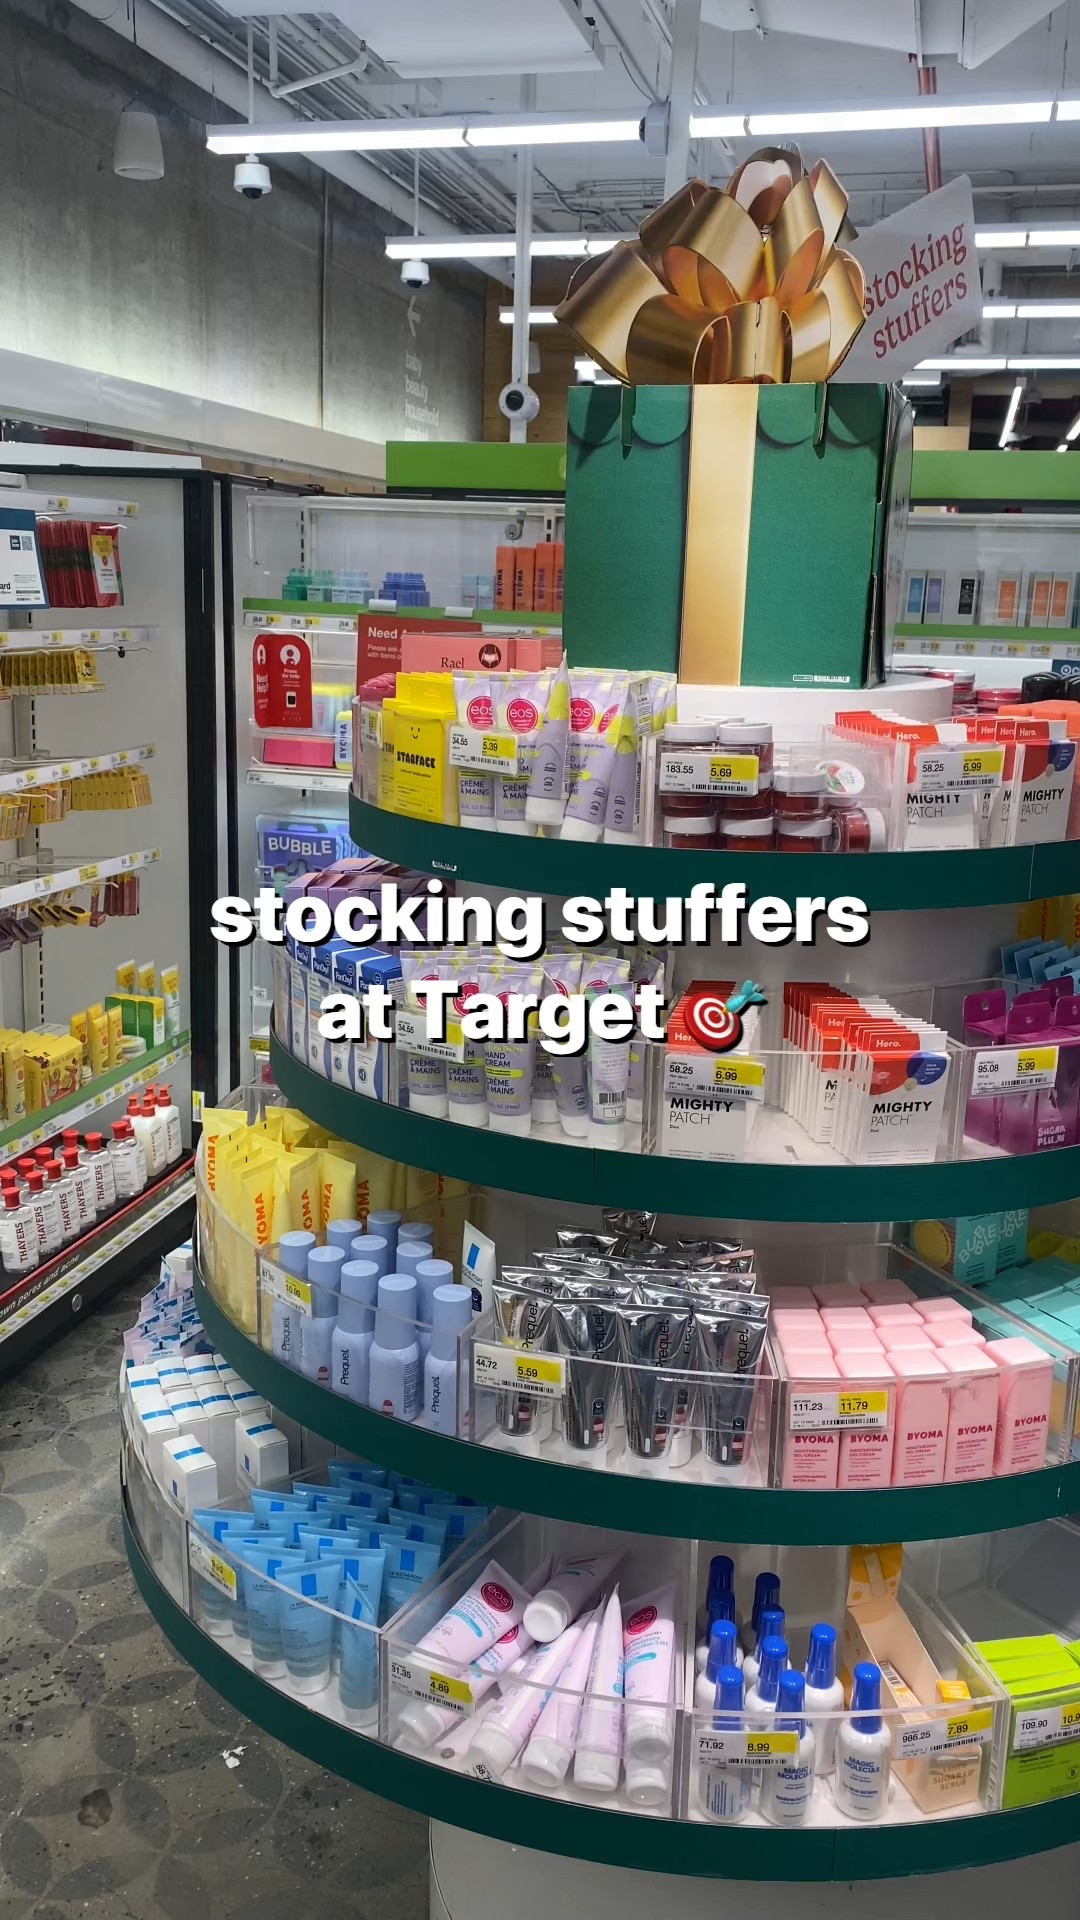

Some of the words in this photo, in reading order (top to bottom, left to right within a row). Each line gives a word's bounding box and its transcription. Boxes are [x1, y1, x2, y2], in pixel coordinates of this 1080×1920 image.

[866, 222, 967, 317] stocking
[873, 271, 967, 359] stuffers
[368, 627, 398, 639] Need
[441, 657, 465, 669] Rael
[509, 708, 534, 718] eos
[896, 731, 921, 741] Hero.
[981, 726, 996, 735] Her
[1019, 728, 1037, 737] Hero.
[452, 736, 469, 747] 34.55
[482, 741, 499, 752] 5.39
[397, 751, 436, 769] STARFACE
[666, 764, 694, 774] 183.55
[710, 767, 732, 778] 5.69
[922, 763, 945, 773] 58.25
[963, 762, 982, 772] 6.99
[465, 787, 490, 796] MAINS
[1023, 788, 1065, 802] MIGHTY
[907, 806, 945, 818] PATCH
[1021, 803, 1050, 816] PATCH
[268, 836, 332, 856] BUBBLE
[313, 958, 330, 976] PanOxyl
[335, 971, 353, 986] PanOxyl
[398, 1023, 415, 1034] 34.55
[828, 1018, 845, 1027] Her
[674, 1032, 696, 1042] Her
[875, 1039, 902, 1048] Hero.
[484, 1052, 506, 1060] HAND
[485, 1058, 511, 1067] CREAM
[416, 1066, 441, 1075] MAINS
[669, 1064, 694, 1075] 58.25
[715, 1070, 738, 1081] 6.99
[977, 1063, 999, 1074] 95.08
[1017, 1062, 1036, 1072] 5.99
[454, 1075, 480, 1083] MAINS
[490, 1086, 515, 1095] MAINS
[669, 1097, 734, 1113] MIGHTY
[872, 1101, 933, 1114] MIGHTY
[669, 1110, 713, 1125] PATCH
[870, 1114, 913, 1127] PATCH
[1038, 1124, 1066, 1137] SUGAR
[95, 1164, 105, 1202] THAYERS
[75, 1180, 88, 1220] THAYERS
[356, 1179, 370, 1221] OMA
[59, 1193, 72, 1232] THAYERS
[301, 1188, 313, 1231] OMA
[254, 1191, 268, 1246] YOMA
[34, 1206, 47, 1246] THAYERS
[15, 1222, 29, 1263] THAYERS
[958, 1225, 997, 1264] BUBBLE
[18, 1282, 43, 1307] pores
[43, 1267, 59, 1287] and
[60, 1254, 80, 1272] acne
[285, 1282, 301, 1299] 10.99
[475, 1359, 498, 1370] 44.72
[517, 1366, 538, 1378] 5.59
[793, 1402, 824, 1412] 111.23
[840, 1401, 869, 1412] 11.79
[1014, 1414, 1048, 1427] BYOMA
[907, 1430, 944, 1441] BYOMA
[957, 1424, 993, 1436] BYOMA
[795, 1434, 835, 1444] BYOMA
[850, 1433, 889, 1443] BYOMA
[487, 1584, 509, 1606] eos
[631, 1610, 653, 1626] eos
[391, 1664, 411, 1679] 31.35
[430, 1680, 450, 1694] 4.89
[1021, 1719, 1048, 1731] 109.90
[1062, 1712, 1080, 1724] 10.9
[902, 1731, 931, 1743] 986.25
[948, 1723, 969, 1736] 7.89
[698, 1740, 724, 1750] 71.92
[747, 1742, 770, 1752] 8.99
[843, 1758, 880, 1774] MOLECULE
[848, 1756, 874, 1768] MAGIC
[777, 1769, 812, 1781] MOLECU
[783, 1766, 809, 1775] MAGIC
